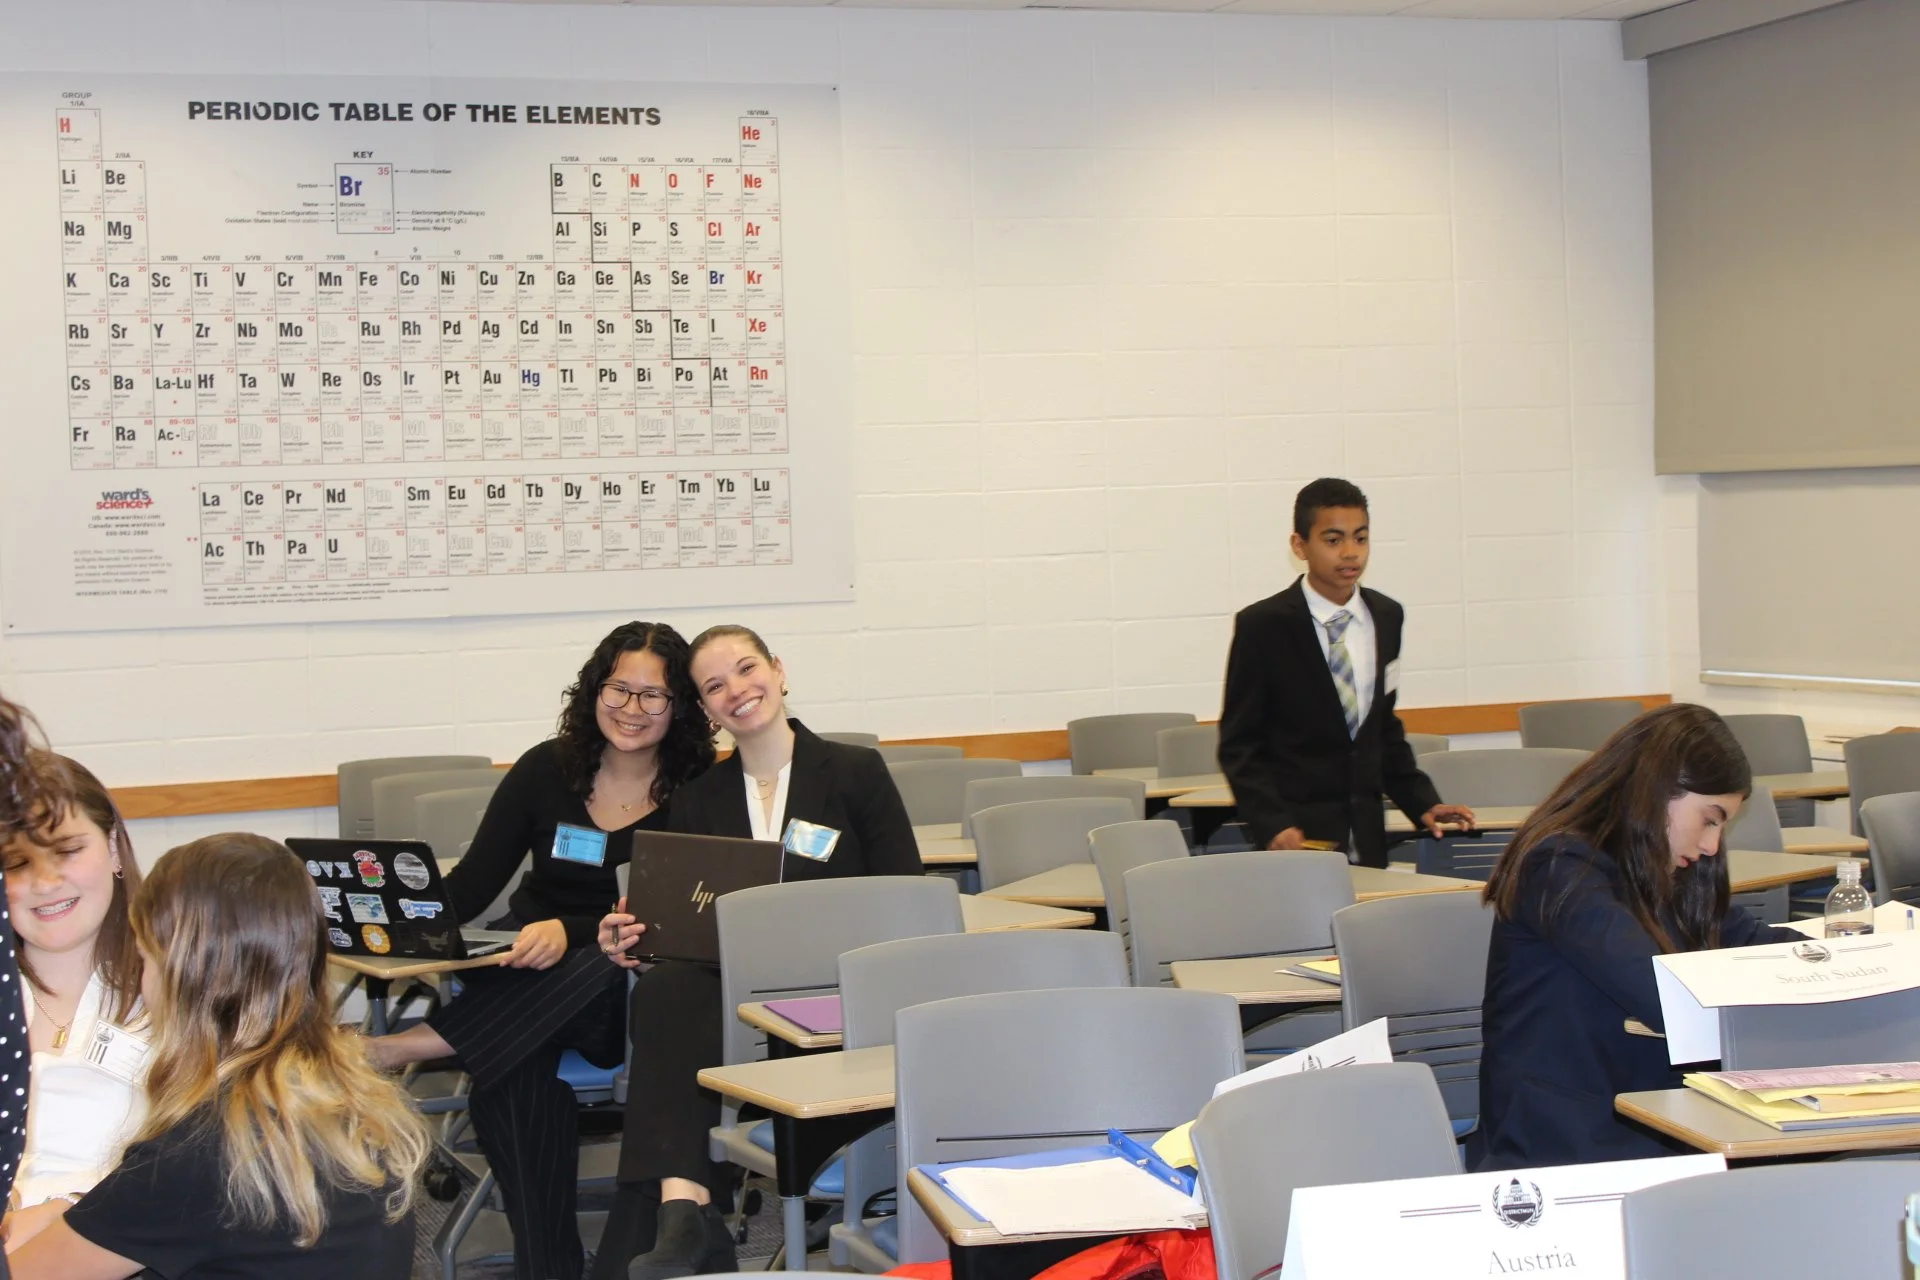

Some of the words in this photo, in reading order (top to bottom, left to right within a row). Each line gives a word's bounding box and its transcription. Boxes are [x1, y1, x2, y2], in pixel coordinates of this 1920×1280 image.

[189, 102, 319, 121] PERIODIC
[329, 103, 414, 121] TABLE
[423, 103, 457, 122] OF
[466, 104, 517, 123] THE
[526, 105, 661, 125] ELEMENTS
[60, 118, 70, 133] H
[742, 126, 760, 140] He
[353, 150, 374, 159] KEY
[62, 169, 75, 184] Li
[105, 170, 125, 185] Be
[377, 166, 389, 176] 35
[340, 175, 362, 196] Br
[554, 173, 563, 187] B
[592, 173, 601, 187] C
[631, 174, 639, 187] N
[669, 174, 677, 188] O
[707, 174, 714, 188] F
[744, 174, 761, 188] Ne
[64, 221, 84, 236] Na
[108, 221, 131, 239] Mg
[556, 222, 569, 236] Al
[594, 222, 606, 236] Si
[632, 222, 640, 236] P
[670, 222, 678, 236] S
[708, 222, 721, 236] Cl
[746, 223, 760, 236] Ar
[67, 273, 76, 287] K
[109, 273, 129, 287] Ca
[152, 273, 170, 287] Sc
[194, 272, 207, 287] Ti
[236, 272, 245, 287] V
[277, 272, 293, 287] Cr
[319, 272, 342, 286] Mn
[360, 272, 377, 286] Fe
[400, 271, 419, 286] Co
[441, 271, 455, 285] Ni
[480, 271, 497, 285] Cu
[518, 271, 534, 285] Zn
[557, 271, 575, 285] Ga
[596, 271, 613, 285] Ge
[634, 271, 651, 285] As
[672, 271, 688, 285] Se
[710, 271, 724, 284] Br
[747, 271, 762, 284] Kr
[69, 324, 88, 339] Rb
[111, 324, 127, 339] Sr
[154, 324, 163, 338] Y
[196, 323, 210, 338] Zr
[238, 323, 257, 337] Nb
[279, 323, 302, 337] Mo
[361, 322, 380, 336] Ru
[402, 321, 421, 335] Rh
[443, 321, 461, 335] Pd
[482, 321, 499, 338] Ag
[520, 320, 538, 334] Cd
[559, 320, 572, 334] In
[597, 320, 614, 334] Sn
[635, 319, 652, 333] Sb
[673, 319, 688, 333] Te
[711, 319, 715, 332] I
[749, 318, 766, 332] Xe
[281, 373, 295, 387] W
[322, 372, 341, 386] Re
[363, 371, 381, 386] Os
[404, 371, 414, 385] Ir
[445, 370, 459, 384] Pt
[483, 370, 501, 384] Au
[522, 369, 540, 387] Hg
[560, 369, 573, 383] Tl
[599, 369, 616, 382] Pb
[637, 368, 650, 382] Bi
[676, 368, 692, 381] Po
[713, 367, 727, 380] At
[750, 366, 768, 380] Rn
[71, 376, 90, 390] Cs
[114, 375, 133, 390] Ba
[156, 377, 191, 389] La-Lu
[198, 374, 214, 388] Hf
[239, 374, 256, 388] Ta
[73, 427, 88, 442] Fr
[116, 426, 135, 441] Ra
[487, 484, 505, 499] Gd
[526, 484, 543, 497] Tb
[565, 483, 581, 499] Dy
[603, 482, 621, 495] Ho
[641, 481, 655, 494] Er
[679, 480, 700, 493] Tm
[717, 479, 734, 492] Yb
[754, 478, 769, 491] Lu
[102, 488, 149, 501] ward's
[203, 492, 220, 506] La
[244, 491, 263, 505] Ce
[286, 490, 301, 504] Pr
[327, 489, 345, 503] Nd
[408, 487, 430, 501] Sm
[449, 486, 465, 500] Eu
[205, 543, 224, 557] Ac
[246, 541, 264, 556] Th
[288, 540, 306, 554] Pa
[328, 539, 337, 553] U
[691, 881, 714, 913] hp
[1775, 971, 1830, 985] South
[1831, 965, 1888, 981] Sudan
[1488, 1245, 1576, 1274] Austria
